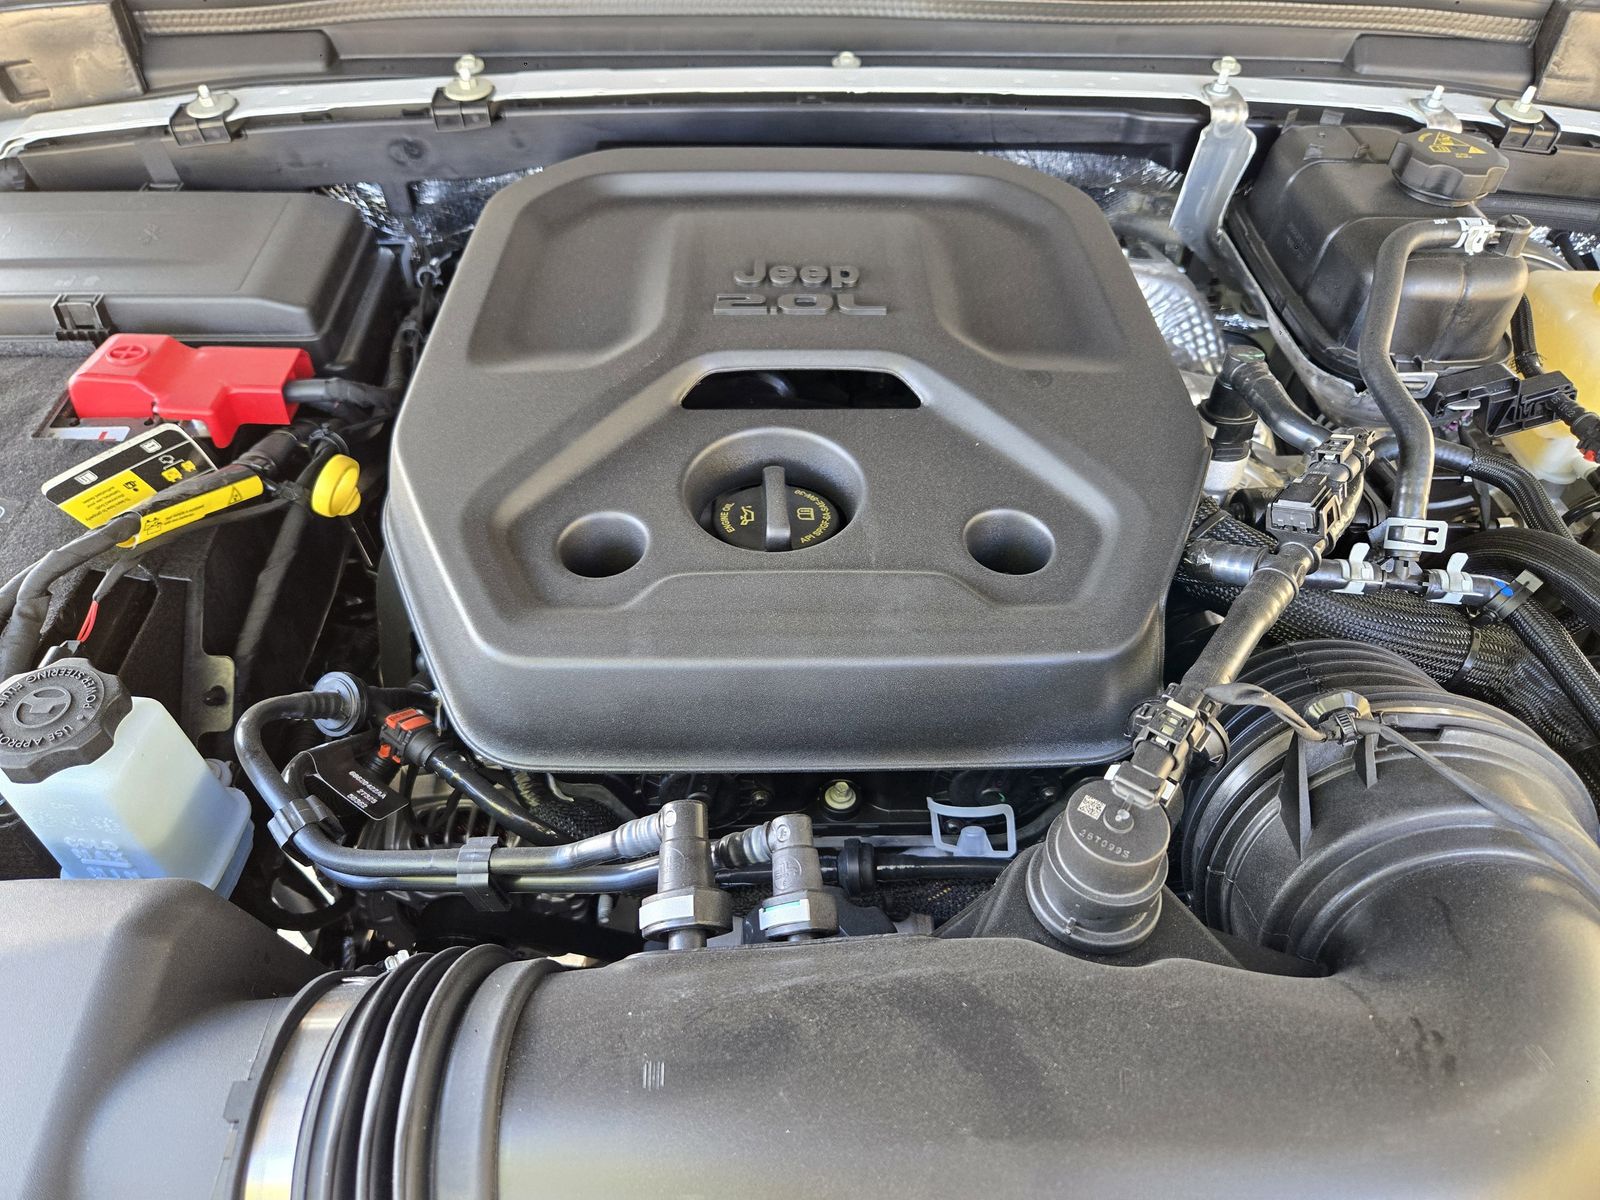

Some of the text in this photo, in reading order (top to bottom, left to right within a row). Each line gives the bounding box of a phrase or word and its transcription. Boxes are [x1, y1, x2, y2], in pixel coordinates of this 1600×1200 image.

[734, 259, 860, 290] Jeep
[713, 293, 888, 316] 2.0L
[720, 512, 736, 533] ENGINE
[800, 533, 816, 543] API
[26, 668, 86, 683] STEERING
[82, 676, 97, 709] POWER
[48, 724, 74, 742] USE
